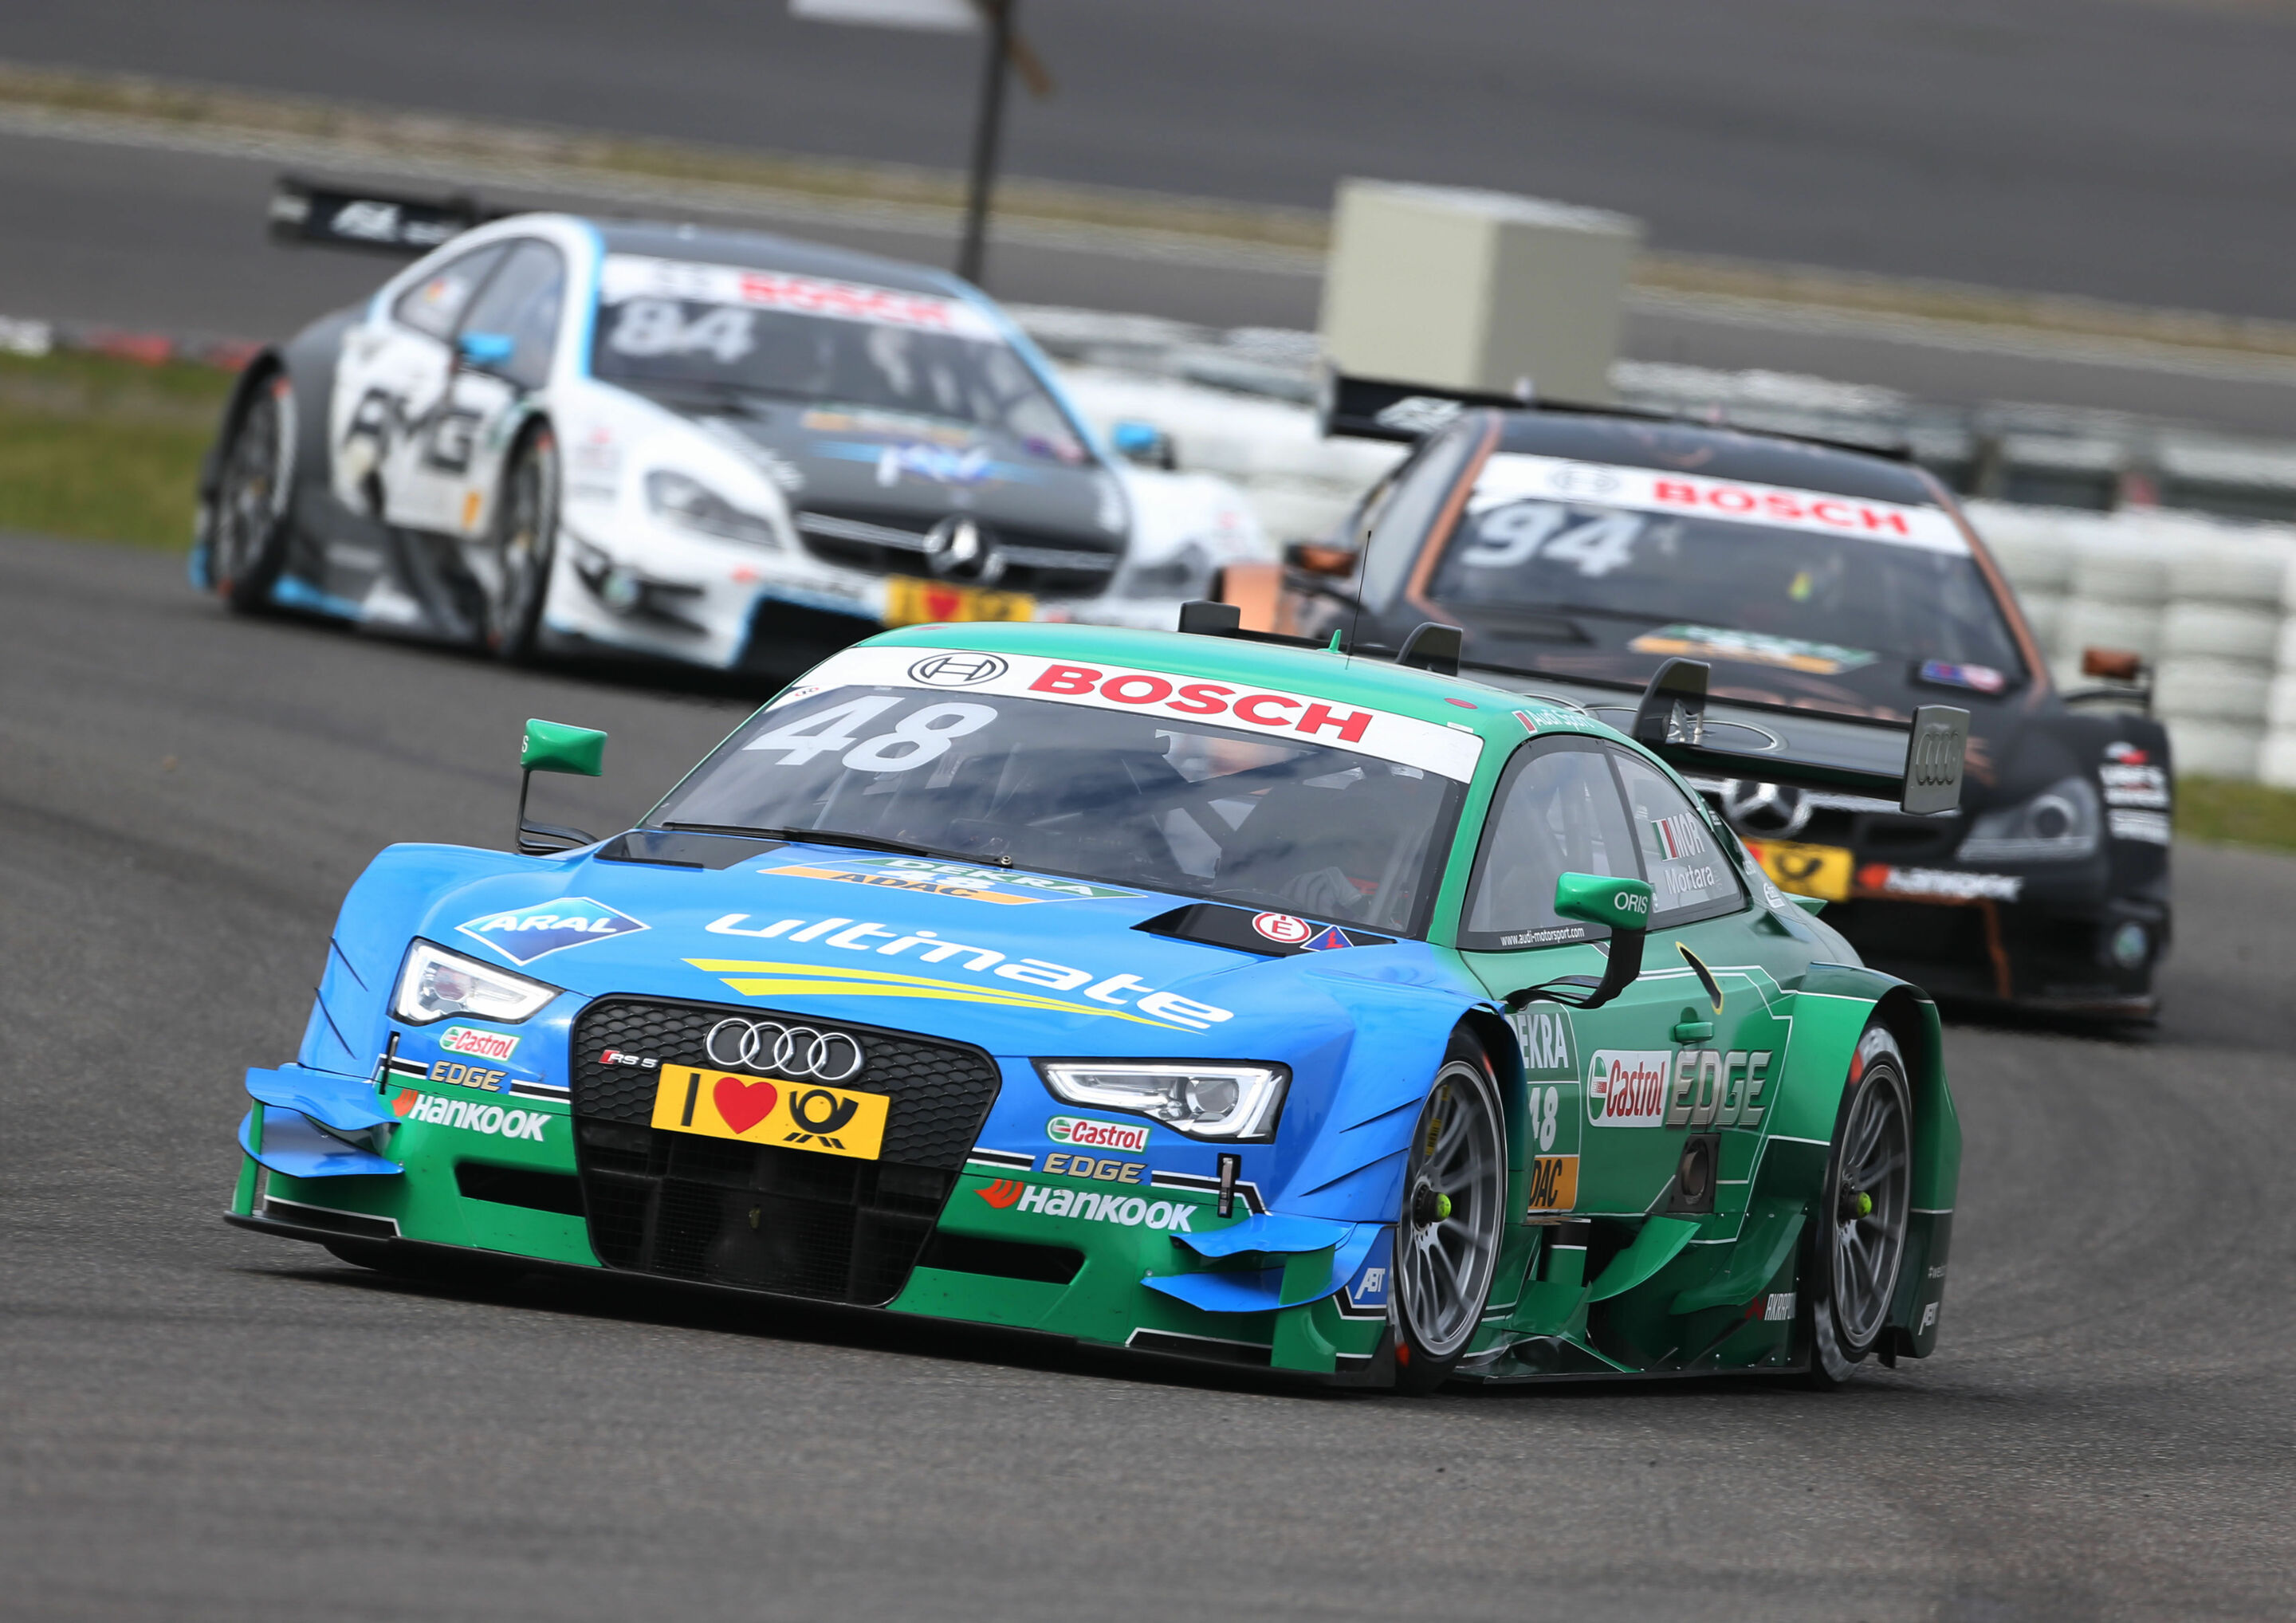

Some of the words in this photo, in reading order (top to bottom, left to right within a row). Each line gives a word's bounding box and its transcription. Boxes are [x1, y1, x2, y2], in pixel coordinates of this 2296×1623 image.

[740, 273, 949, 328] BOSCH
[608, 300, 757, 364] 84
[1653, 479, 1909, 536] BOSCH
[1462, 500, 1645, 576] 94
[1028, 664, 1373, 743] BOSCH
[1524, 709, 1563, 727] Audi
[741, 695, 998, 772] 48
[1666, 812, 1706, 859] MOR
[828, 872, 979, 898] ADAC
[887, 859, 1095, 897] DEKRA
[1665, 864, 1715, 895] Mortara
[1614, 891, 1649, 914] ORIS
[478, 914, 617, 933] ARAL
[1500, 925, 1585, 946] www.audi-motorsport.com
[705, 914, 1234, 1029] ultimate
[456, 1031, 516, 1060] Castrol
[607, 1053, 639, 1065] RS
[641, 1058, 659, 1068] 5
[429, 1062, 509, 1091] EDGE
[1606, 1059, 1666, 1118] Castrol
[1665, 1048, 1773, 1128] EDGE
[680, 1072, 702, 1127] I
[1071, 1120, 1144, 1150] Castrol
[1041, 1152, 1146, 1185] EDGE
[1529, 1158, 1563, 1208] DAC
[1355, 1267, 1386, 1300] ABT
